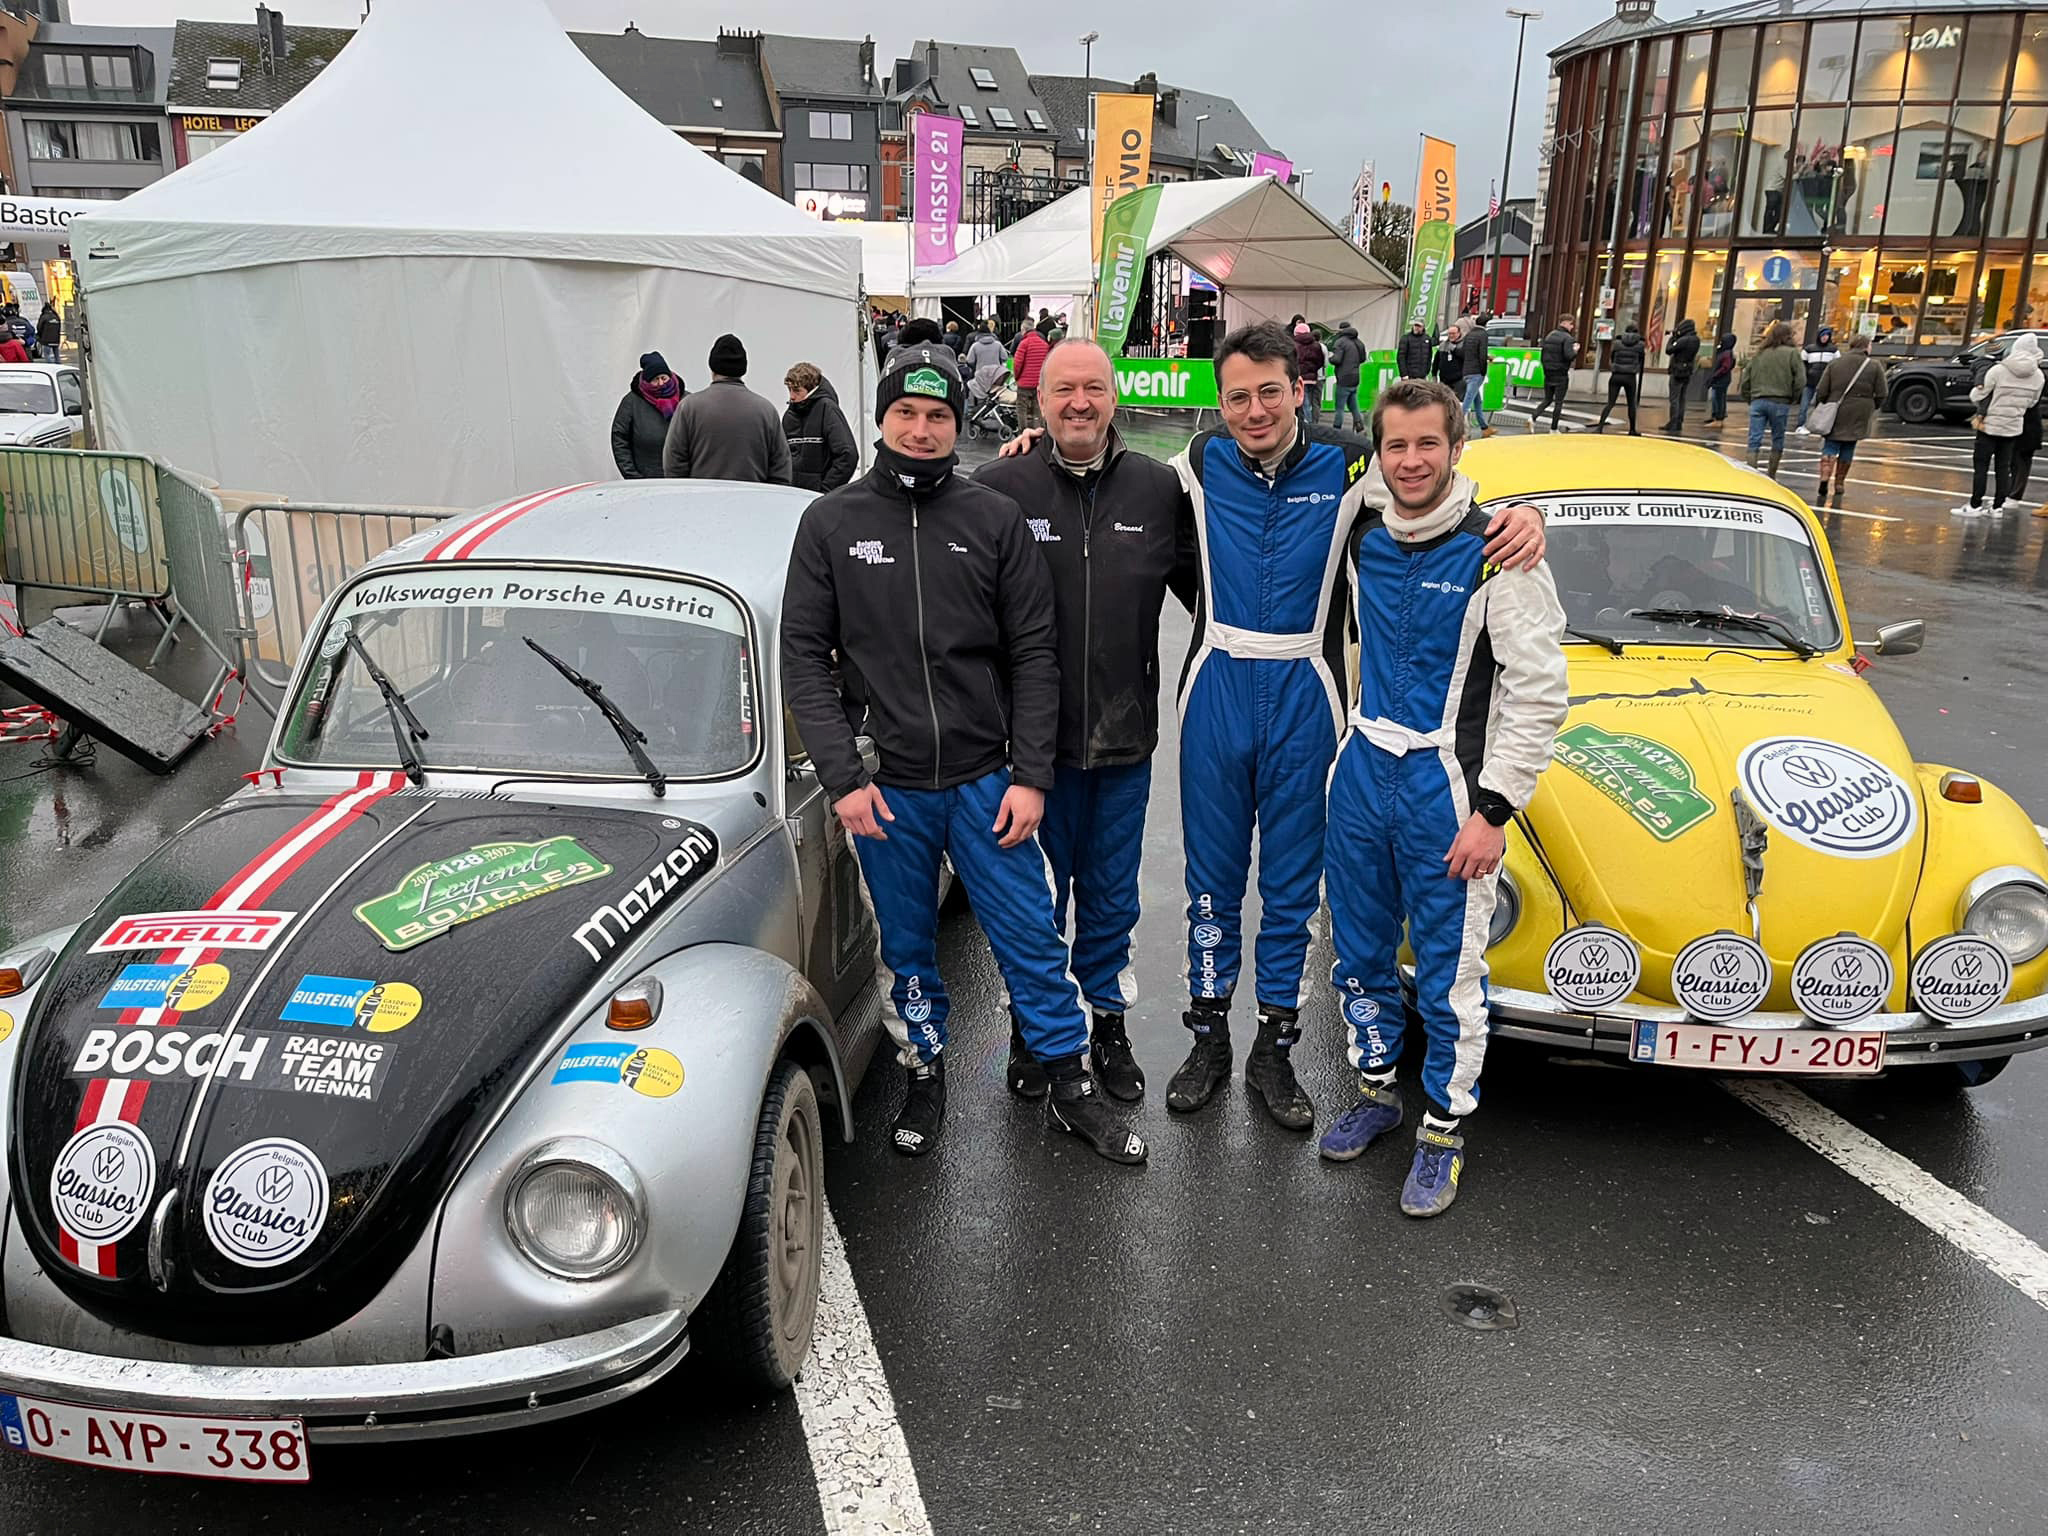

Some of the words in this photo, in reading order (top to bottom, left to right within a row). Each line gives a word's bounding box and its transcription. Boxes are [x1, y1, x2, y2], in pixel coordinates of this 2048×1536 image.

[182, 115, 223, 130] HOTEL
[931, 130, 949, 155] 21
[930, 159, 948, 246] CLASSIC
[1, 202, 87, 227] Basto
[1102, 242, 1136, 332] l'avenir
[1116, 362, 1191, 398] venir
[1554, 502, 1632, 521] Joyeux
[1636, 502, 1765, 525] Condruziens
[849, 544, 885, 557] BUGGY
[354, 585, 494, 608] Volkswagen
[502, 582, 606, 606] Porsche
[613, 588, 715, 620] Austria
[1639, 746, 1674, 768] 127
[1763, 743, 1799, 761] Belgian
[1776, 771, 1893, 834] Classics
[1842, 804, 1885, 833] Club
[440, 853, 485, 876] 128
[393, 861, 595, 941] BOUCLES
[99, 915, 282, 947] PIRELLI
[1582, 936, 1611, 944] Belgian
[1715, 943, 1744, 952] Belgian
[1836, 946, 1867, 954] Belgian
[1957, 945, 1987, 953] Belgian
[112, 978, 170, 992] BILSTEIN
[1201, 950, 1217, 999] Belgian
[1549, 966, 1633, 986] Classics
[1676, 973, 1762, 995] Classics
[1917, 975, 2002, 996] Classics
[1575, 986, 1605, 997] Club
[1796, 975, 1883, 998] Classics
[292, 990, 358, 1009] BILSTEIN
[1701, 994, 1732, 1006] Club
[1821, 998, 1853, 1010] Club
[1940, 996, 1972, 1008] Club
[72, 1029, 271, 1081] BOSCH
[284, 1035, 384, 1062] RACING
[280, 1052, 378, 1084] TEAM
[560, 1055, 622, 1071] BILSTEIN
[293, 1077, 373, 1100] VIENNA
[106, 1132, 135, 1148] Belgian
[271, 1151, 305, 1169] Belgian
[57, 1167, 139, 1215] Classics
[74, 1203, 104, 1224] Club
[212, 1184, 309, 1238] Classics
[232, 1222, 269, 1245] Club
[6, 1426, 23, 1446] B
